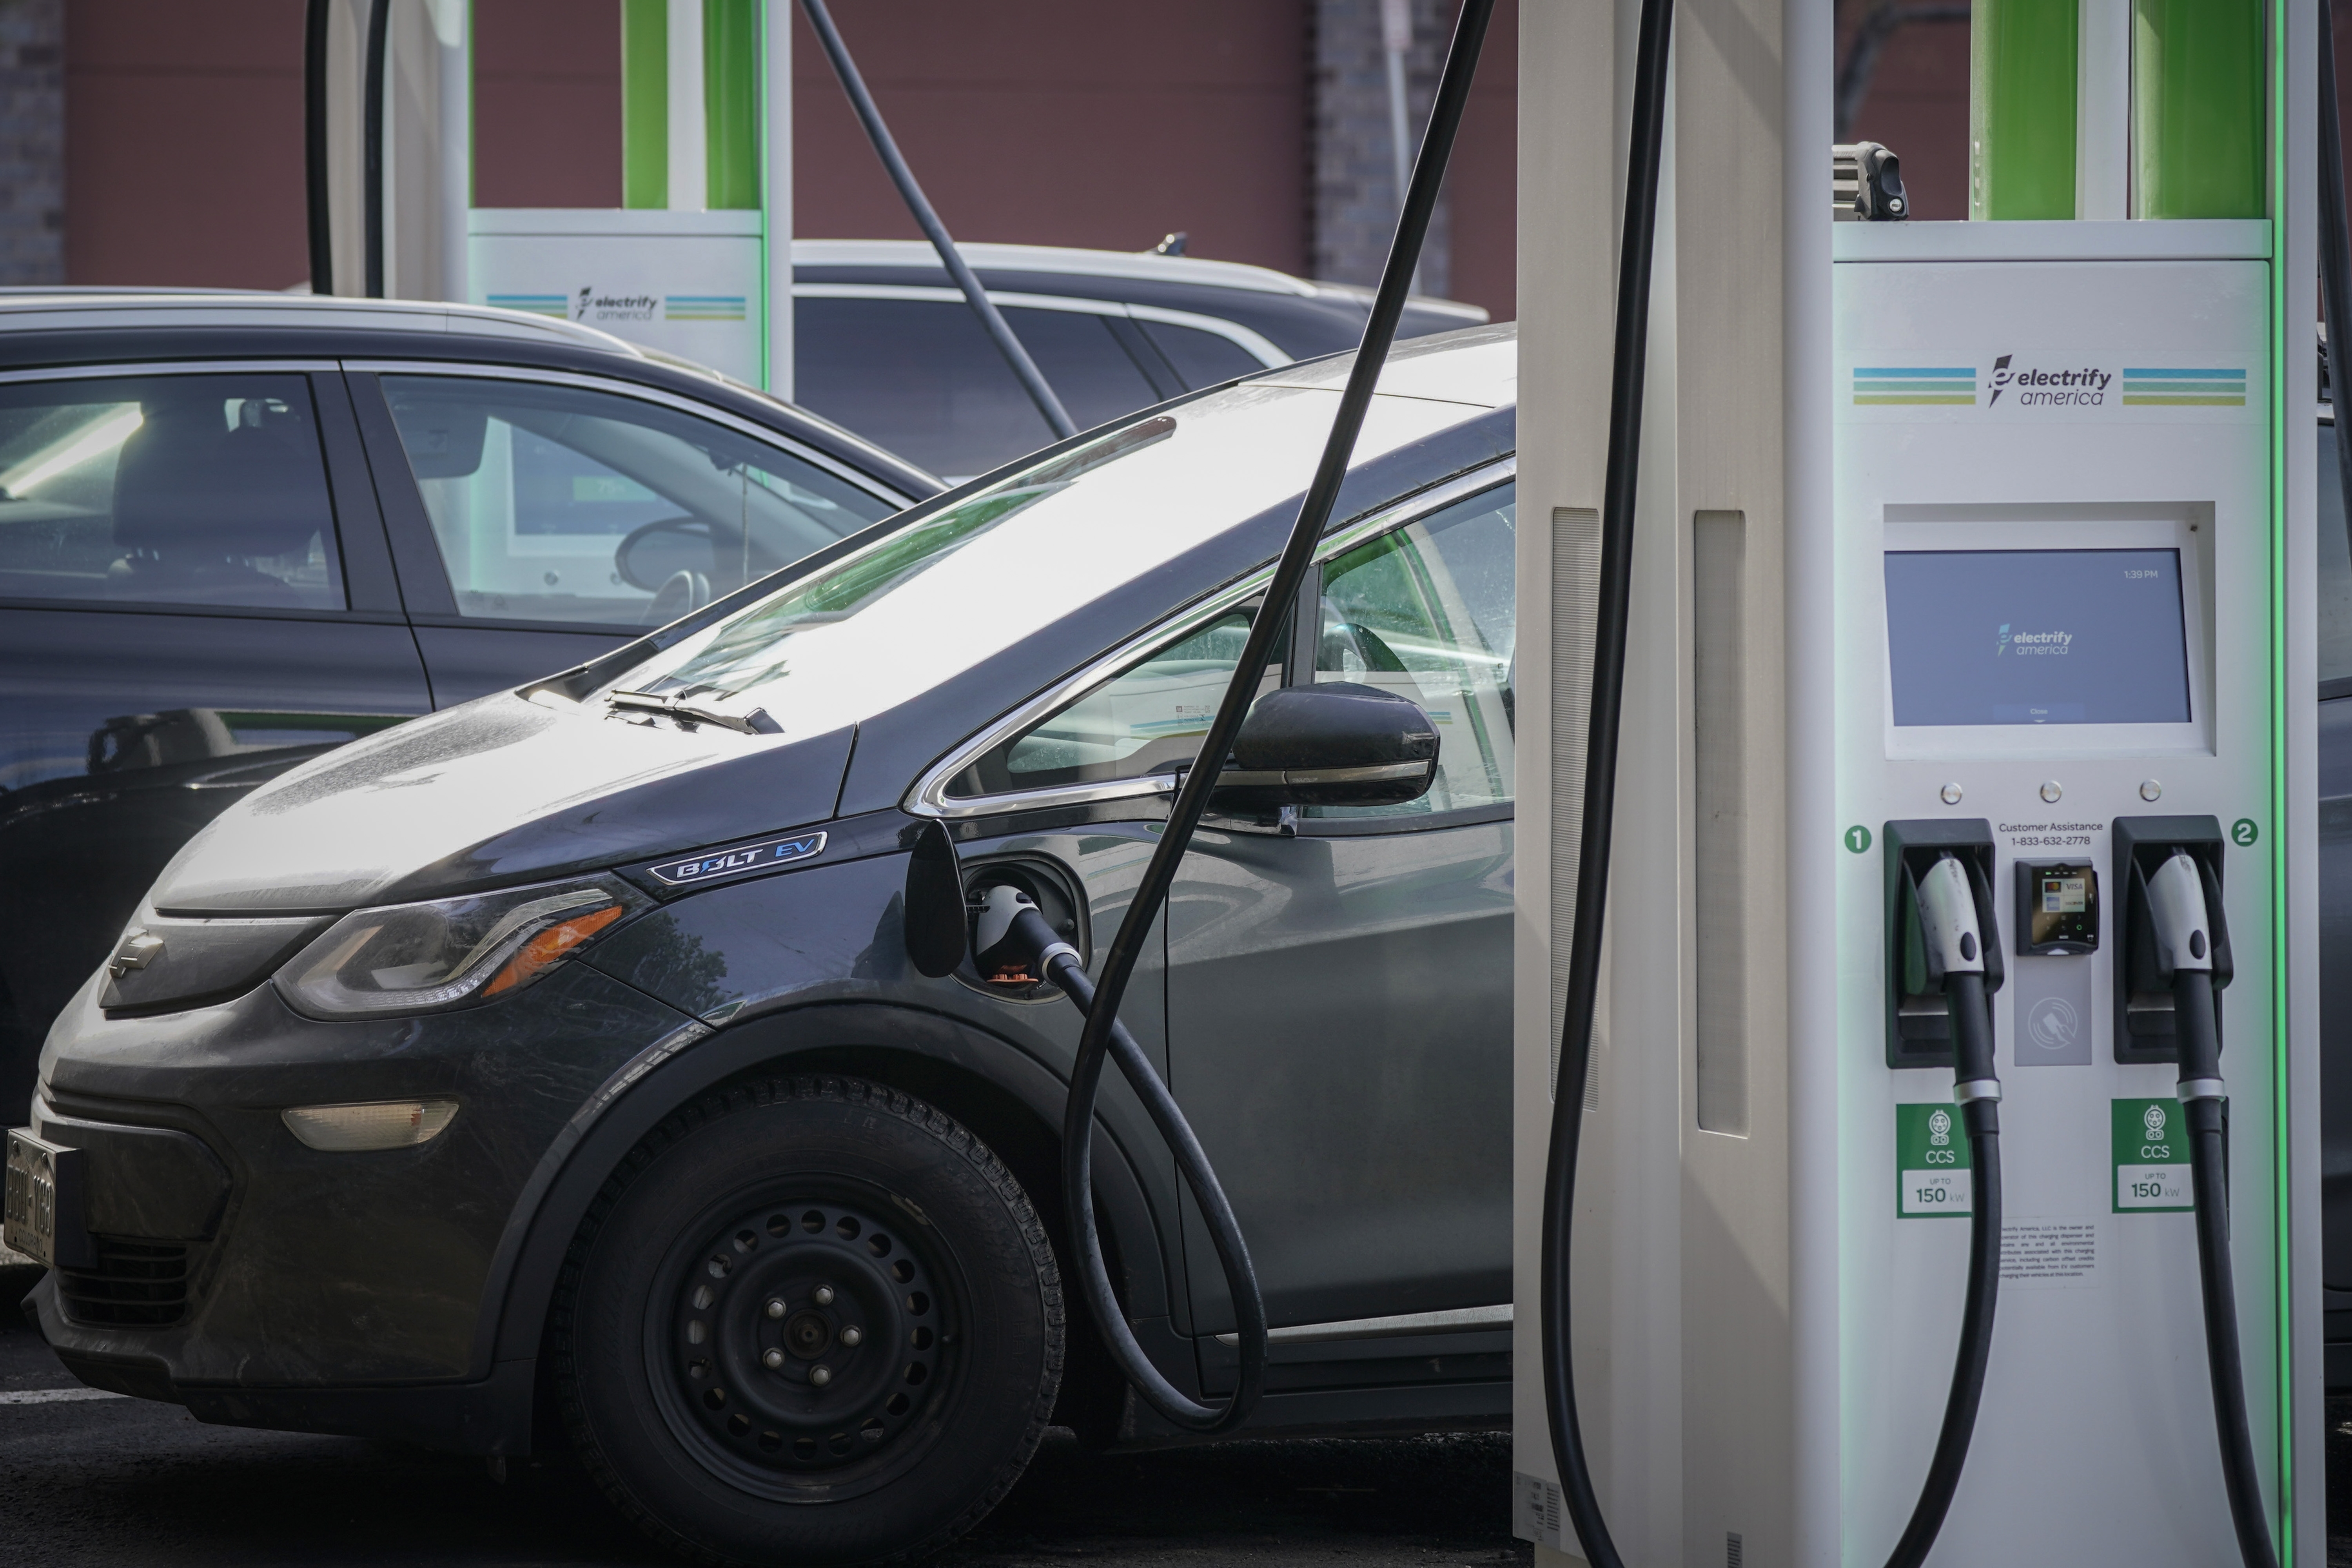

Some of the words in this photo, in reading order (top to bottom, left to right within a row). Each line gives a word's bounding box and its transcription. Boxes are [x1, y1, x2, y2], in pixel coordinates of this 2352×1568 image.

[595, 295, 657, 310] electrify
[597, 309, 652, 320] america
[2018, 368, 2112, 390] electrify
[2021, 389, 2104, 405] america
[2124, 570, 2143, 579] 1:39
[2144, 570, 2158, 578] PM
[2014, 631, 2073, 646] electrify
[2016, 644, 2069, 655] america
[1999, 823, 2048, 832] Customer
[2050, 822, 2103, 831] Assistance
[2238, 823, 2252, 842] 2
[1852, 829, 1862, 849] 1
[2011, 836, 2091, 846] 1-833-632-2778
[677, 849, 764, 878] BOLT
[775, 838, 815, 858] EV
[1926, 1150, 1955, 1164] CCS
[2141, 1145, 2170, 1159] CCS
[1916, 1188, 1946, 1203] 150
[1950, 1193, 1965, 1202] kW
[2131, 1183, 2161, 1198] 150
[2165, 1188, 2180, 1197] kW
